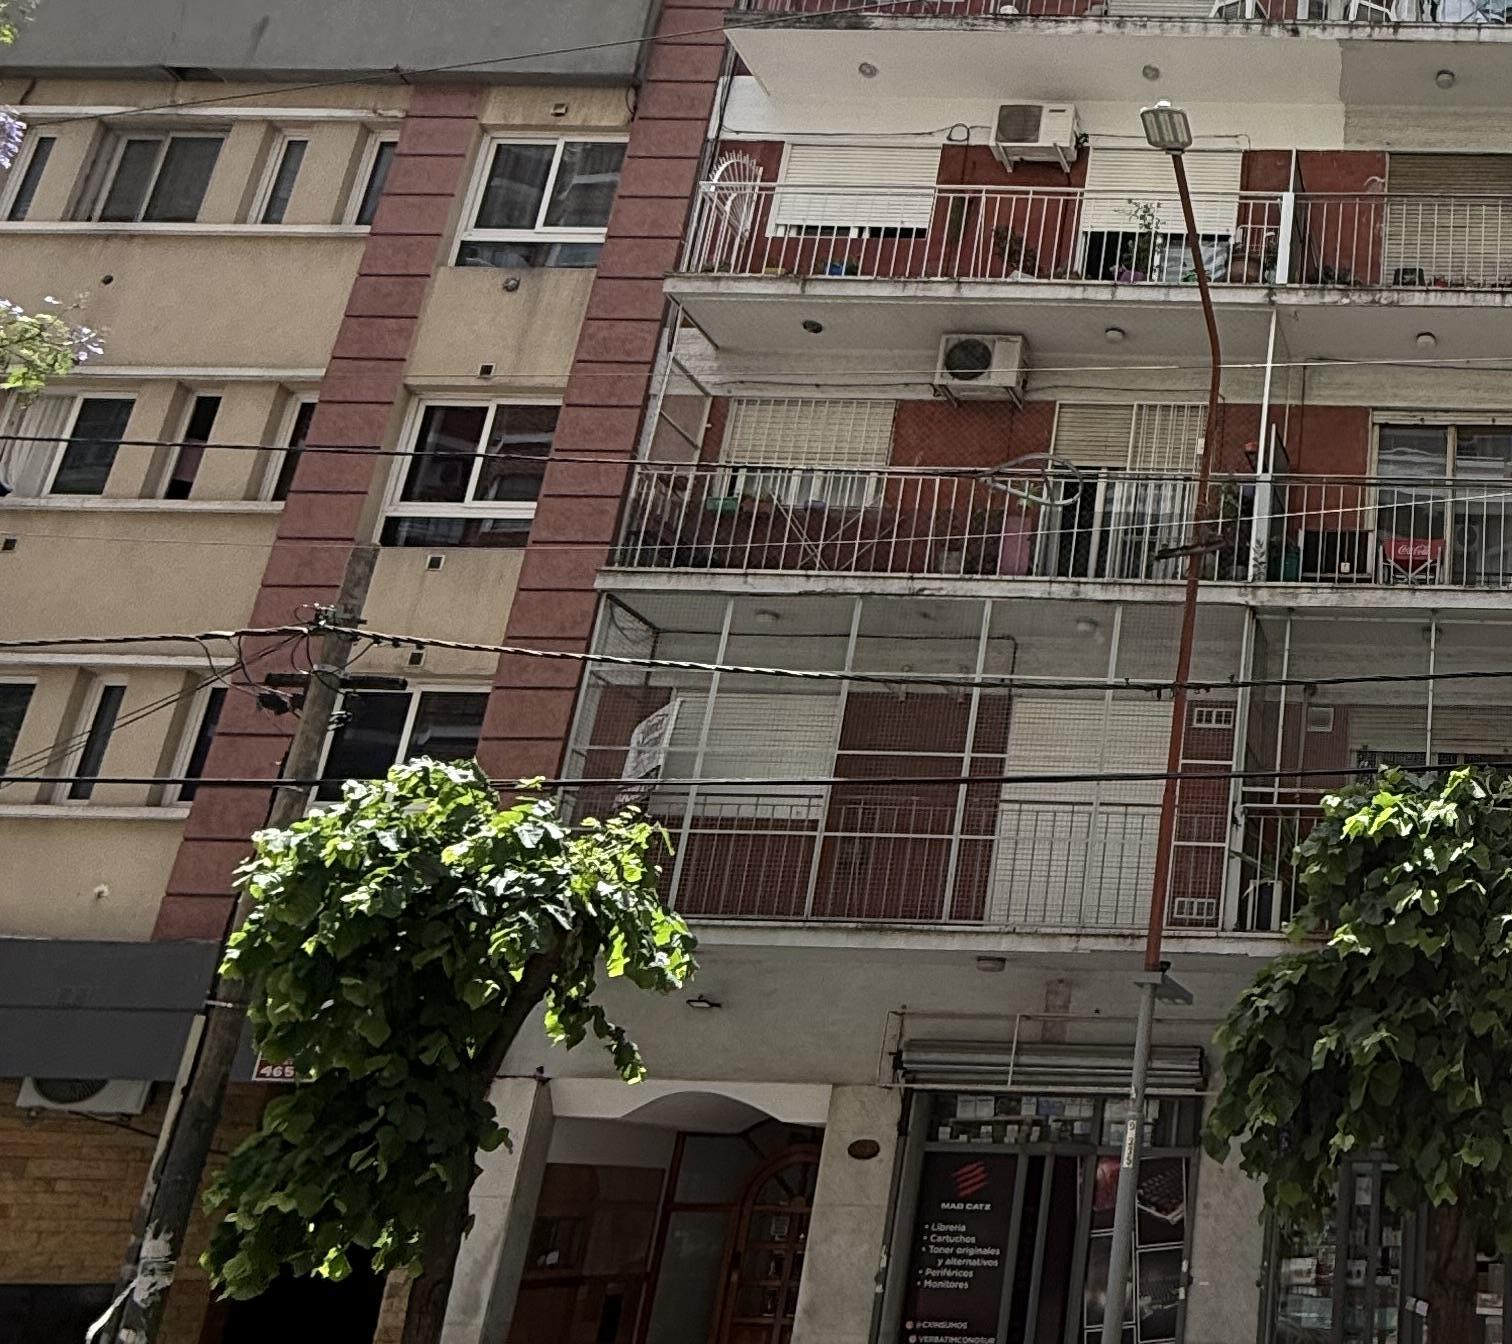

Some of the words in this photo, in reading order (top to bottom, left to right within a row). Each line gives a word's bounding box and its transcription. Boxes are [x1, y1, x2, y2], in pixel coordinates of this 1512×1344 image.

[1397, 544, 1430, 556] Coc-Cola
[259, 1065, 297, 1078] 465
[941, 1202, 964, 1210] MAD
[930, 1234, 976, 1243] Cartuchos
[956, 1247, 1000, 1256] originales
[937, 1258, 944, 1267] y
[945, 1257, 999, 1267] alternativos
[923, 1279, 969, 1289] Monitores
